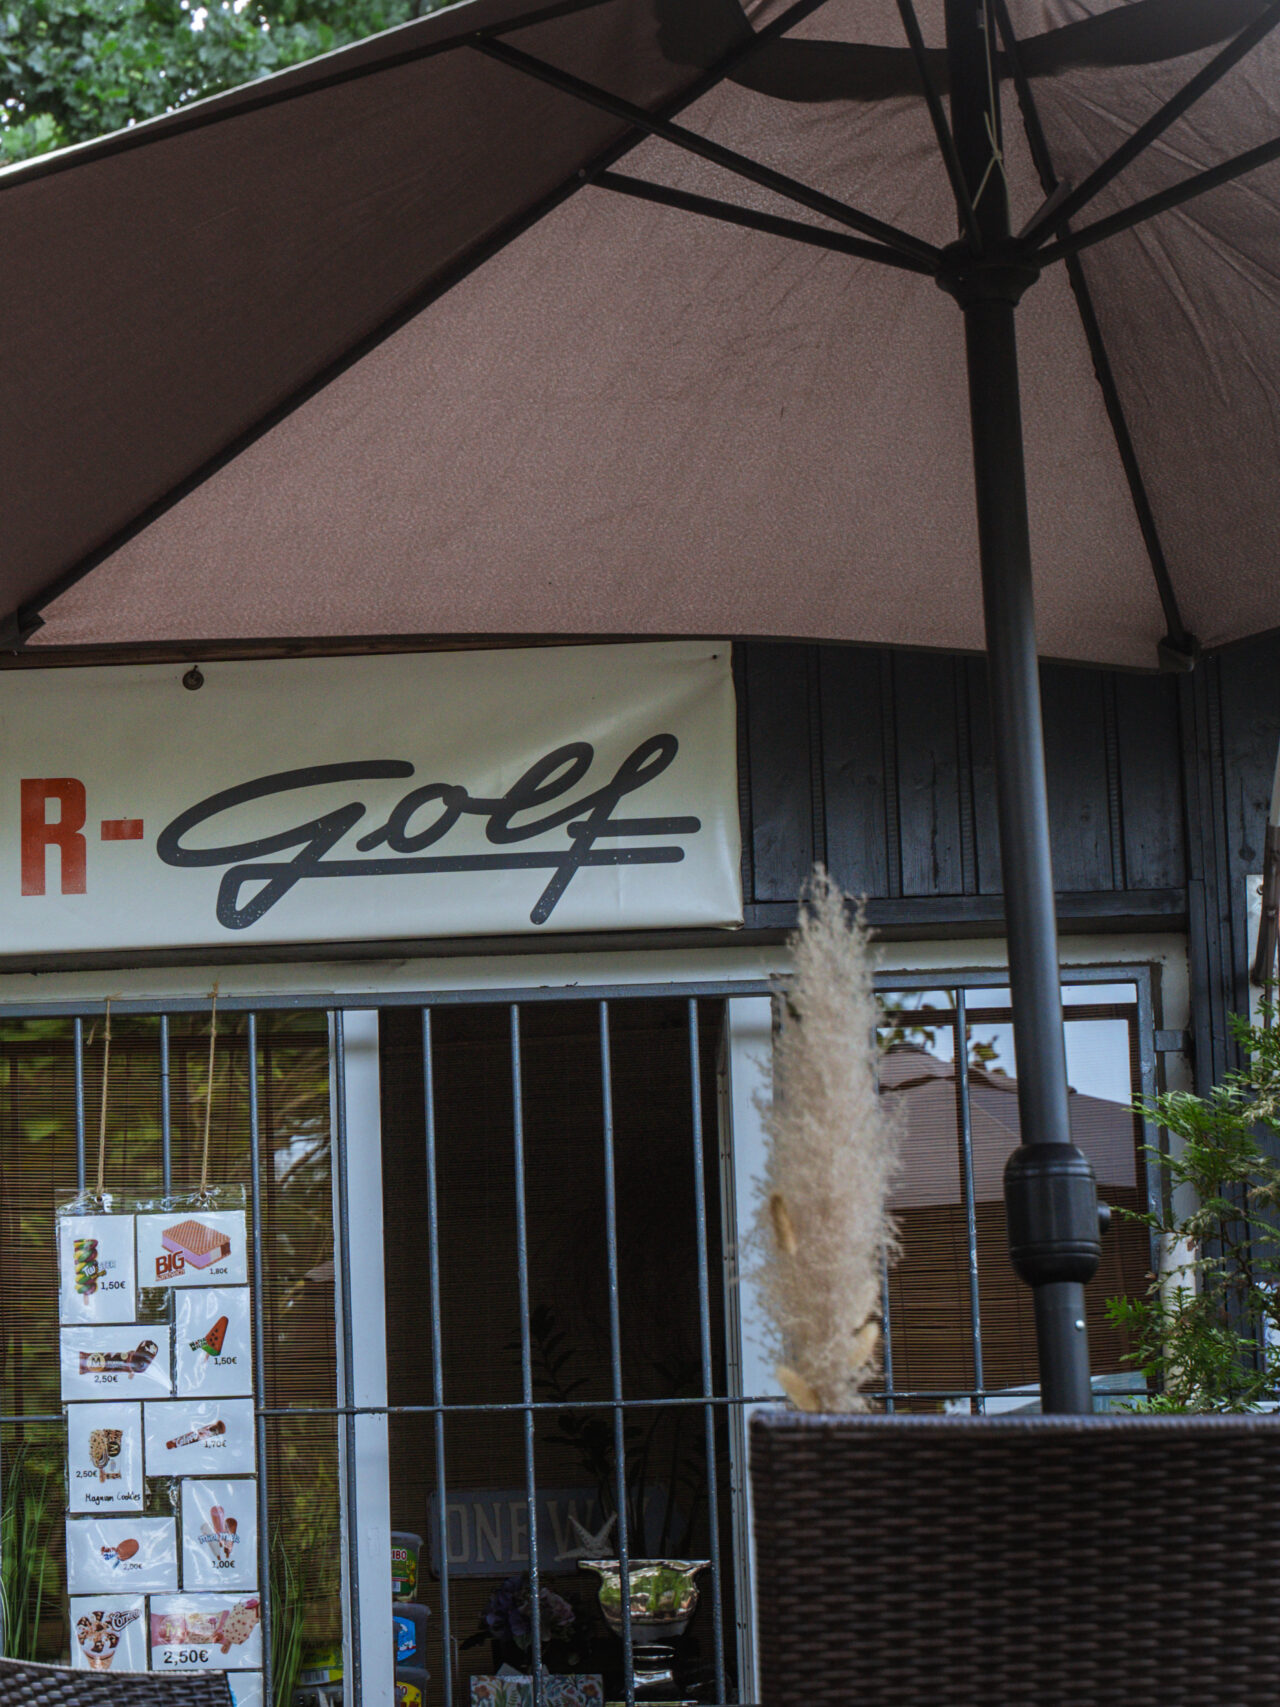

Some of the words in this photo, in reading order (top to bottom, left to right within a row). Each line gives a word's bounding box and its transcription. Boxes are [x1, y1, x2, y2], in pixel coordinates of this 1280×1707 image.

[157, 733, 701, 932] Golf
[155, 1251, 185, 1276] BIG
[100, 1281, 126, 1290] 1,50€
[214, 1357, 238, 1365] 1,50€
[94, 1375, 118, 1383] 2,50€
[392, 1550, 407, 1560] IBO
[163, 1649, 209, 1666] 2,50€
